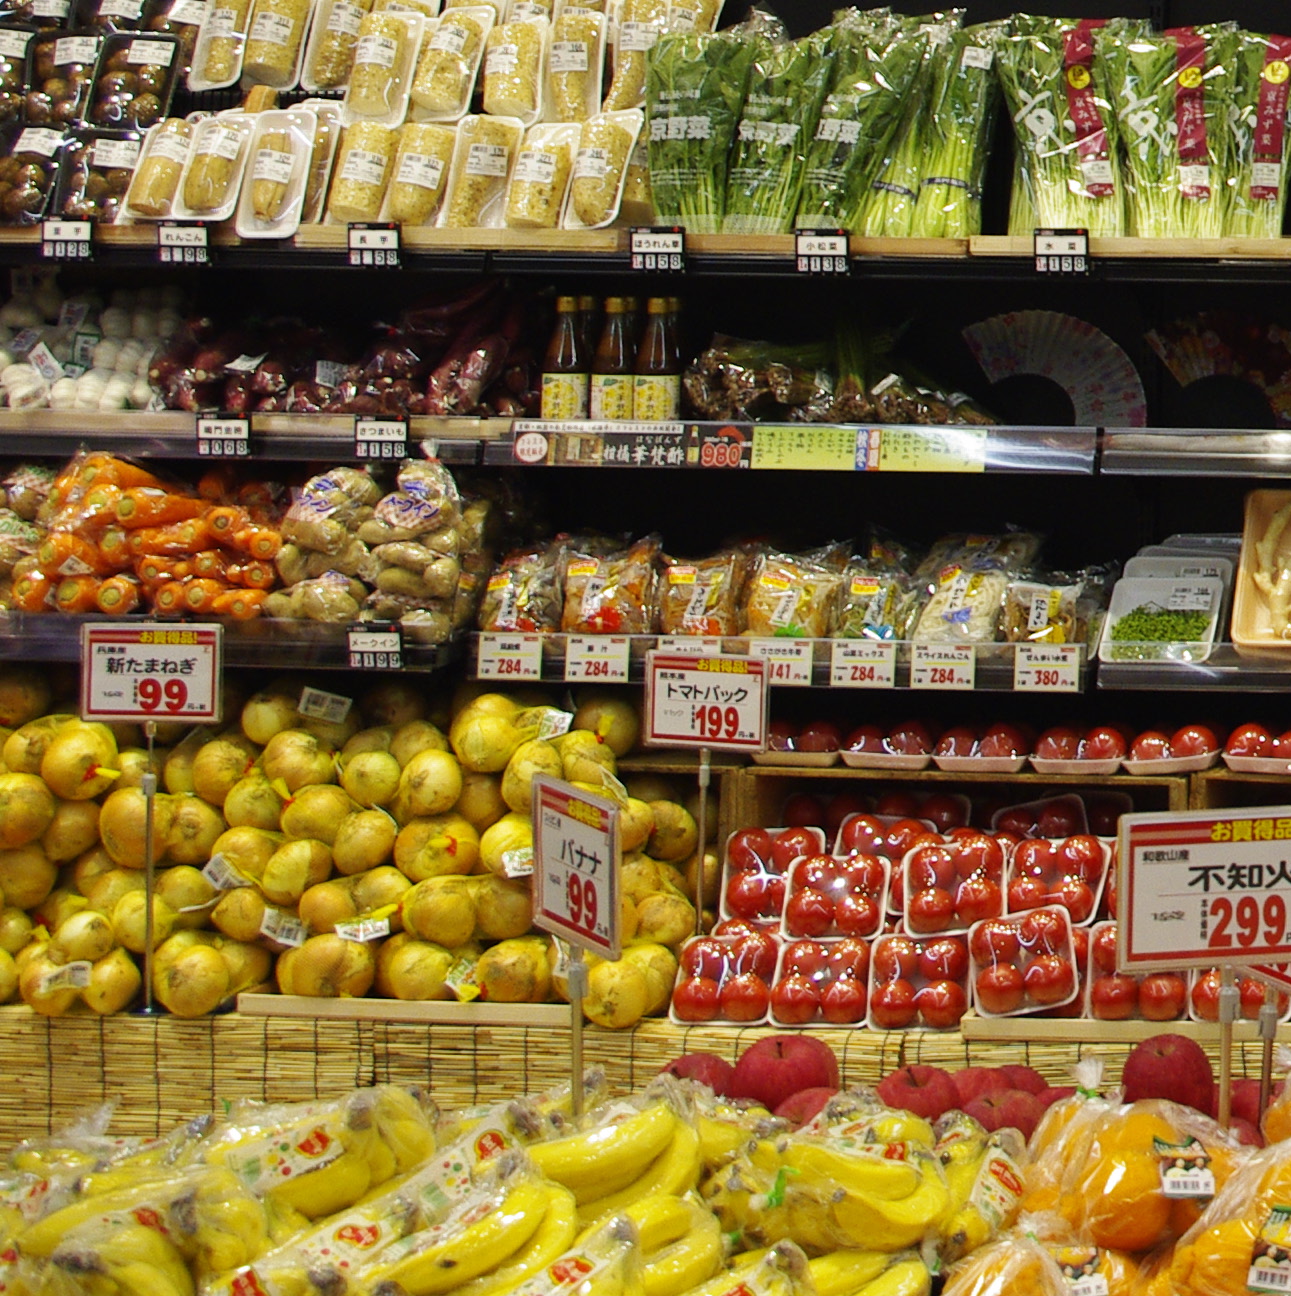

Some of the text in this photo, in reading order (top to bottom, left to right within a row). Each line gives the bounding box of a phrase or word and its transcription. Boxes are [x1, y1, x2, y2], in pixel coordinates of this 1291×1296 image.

[650, 115, 711, 142] 京野菜
[166, 233, 203, 242] れんこん
[806, 242, 838, 251] 小松菜
[360, 427, 405, 436] さつまいも
[702, 443, 742, 465] 980
[140, 631, 198, 644] お買得品!
[352, 637, 399, 647] メークイン
[106, 657, 198, 675] 新たまねぎ
[498, 659, 521, 674] 284
[585, 661, 608, 676] 284
[697, 659, 748, 673] お買得品!
[851, 666, 875, 681] 284
[930, 668, 955, 683] 284
[1034, 670, 1059, 686] 380
[139, 677, 188, 711] 99
[695, 705, 739, 738] 199
[560, 838, 603, 874] バナナ
[1142, 849, 1190, 862] 和歌山産
[568, 872, 598, 931] 99
[1208, 894, 1286, 948] 299
